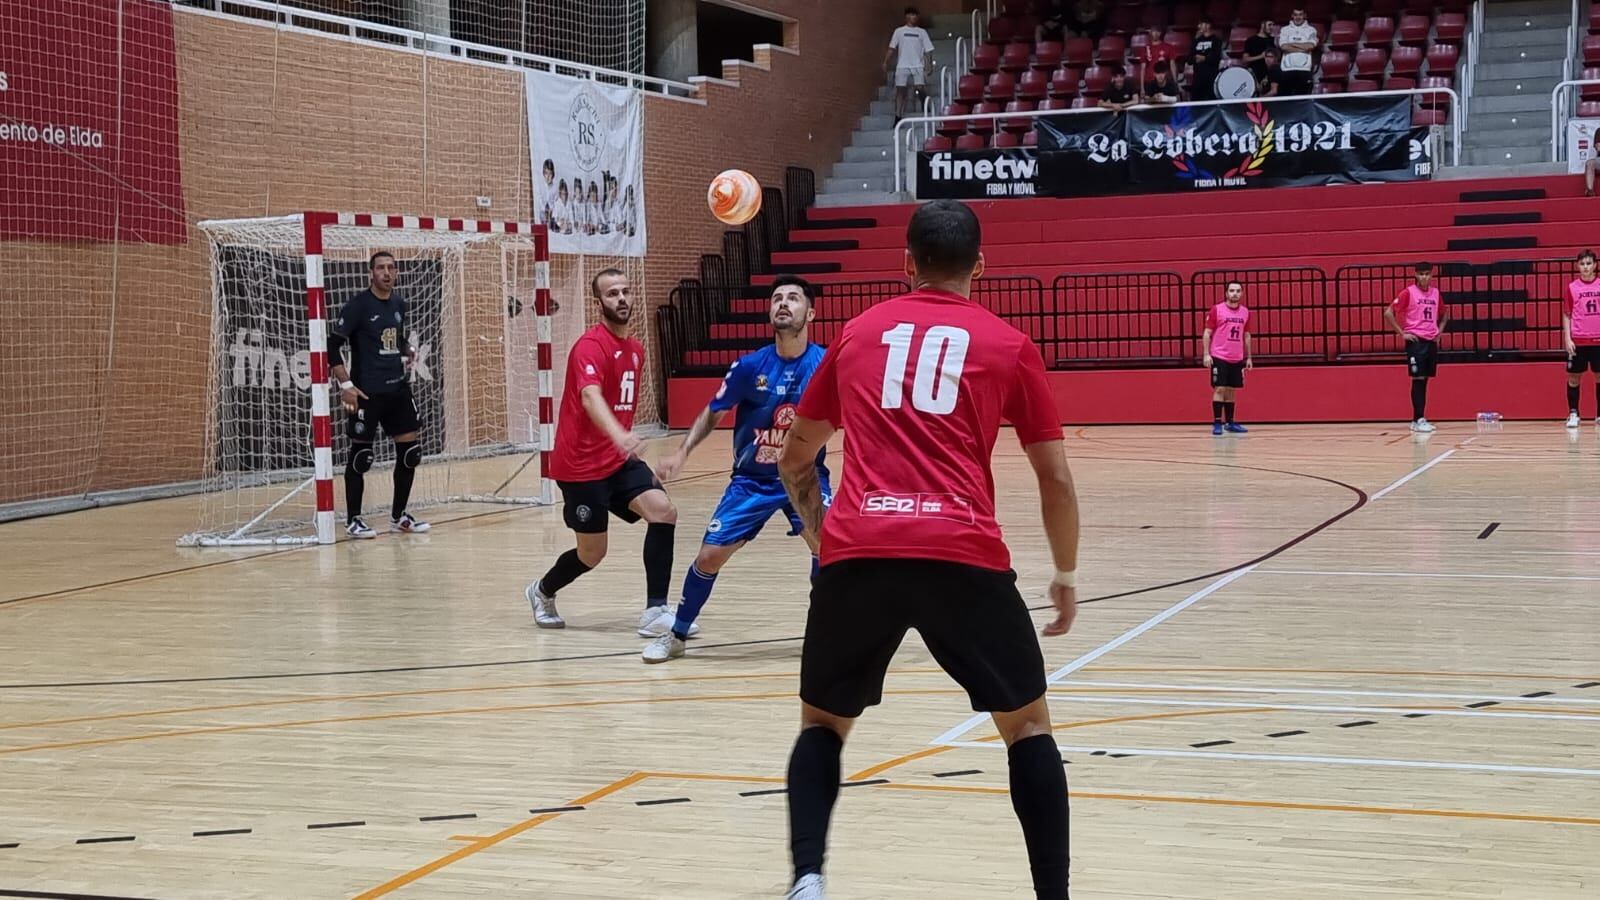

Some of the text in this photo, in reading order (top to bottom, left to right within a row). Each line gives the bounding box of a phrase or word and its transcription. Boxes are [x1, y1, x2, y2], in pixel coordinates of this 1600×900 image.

[42, 122, 66, 144] de
[69, 125, 103, 148] Elda
[578, 122, 596, 145] RS
[1271, 121, 1356, 153] 1921
[929, 152, 1038, 180] finetw
[986, 183, 1007, 195] FIBRA
[1008, 183, 1013, 195] Y
[881, 322, 970, 415] 10
